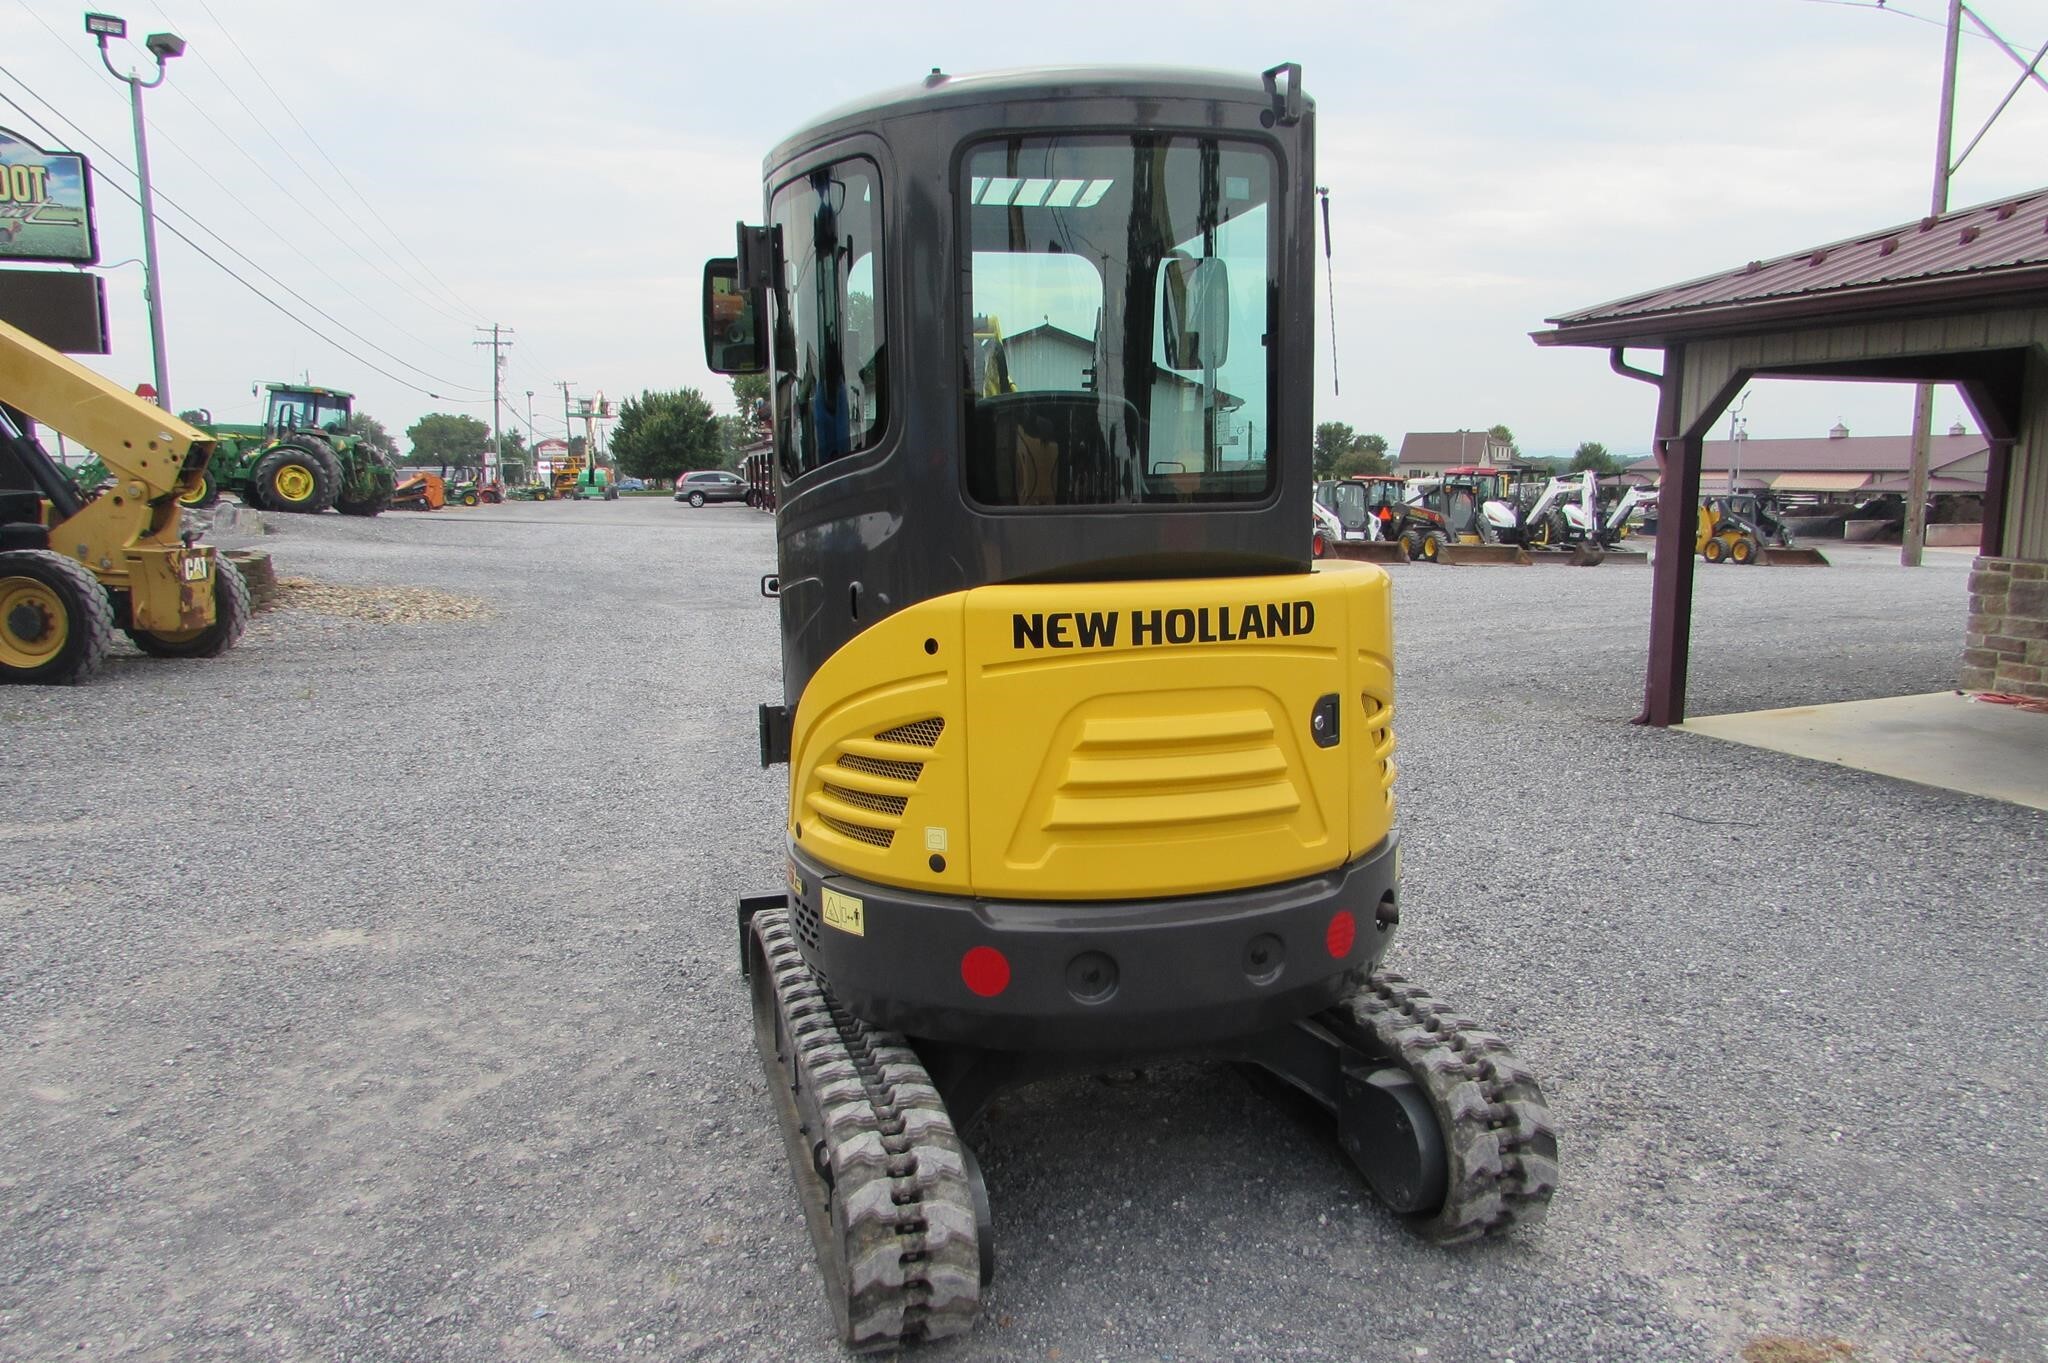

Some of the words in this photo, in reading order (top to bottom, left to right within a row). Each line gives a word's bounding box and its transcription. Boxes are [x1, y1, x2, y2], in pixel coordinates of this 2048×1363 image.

[185, 556, 208, 580] CAT
[1012, 611, 1119, 649] NEW
[1131, 600, 1315, 646] HOLLAND
